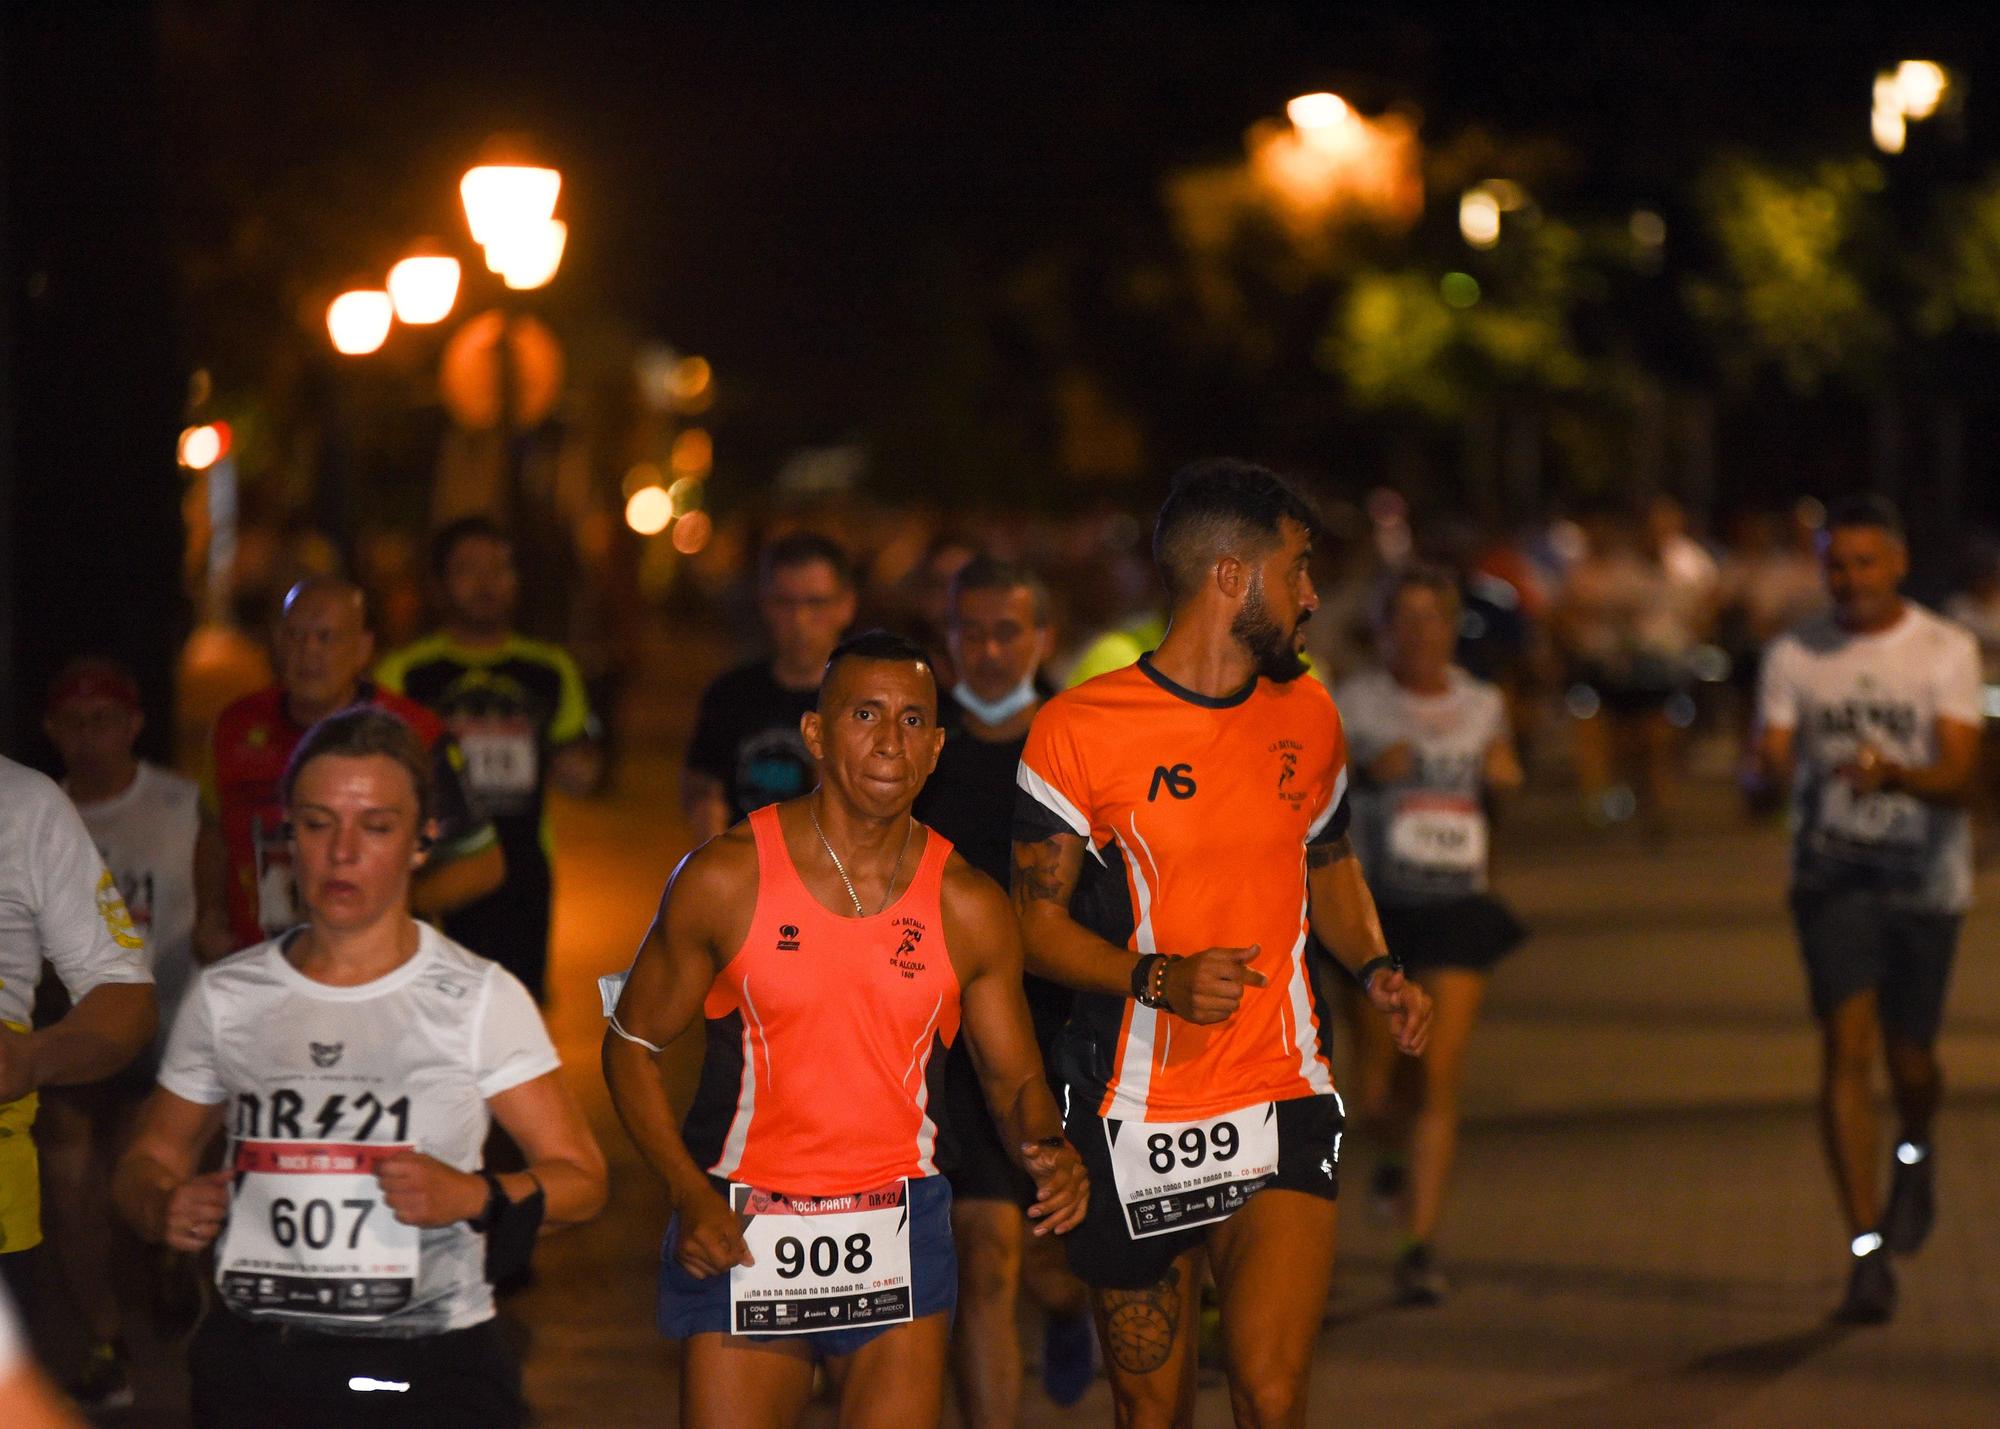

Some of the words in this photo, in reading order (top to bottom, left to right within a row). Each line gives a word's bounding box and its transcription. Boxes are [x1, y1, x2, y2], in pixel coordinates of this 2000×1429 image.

[902, 917, 926, 930] BATALLA
[889, 958, 898, 967] DE
[899, 960, 926, 971] ALCOLEA
[1147, 1121, 1239, 1174] 899
[792, 1200, 816, 1212] ROCK
[820, 1197, 852, 1212] PARTY
[271, 1198, 376, 1250] 607
[775, 1233, 873, 1279] 908
[763, 1289, 772, 1297] NA
[774, 1288, 783, 1297] NA
[809, 1287, 818, 1295] NA
[820, 1286, 829, 1294] NA
